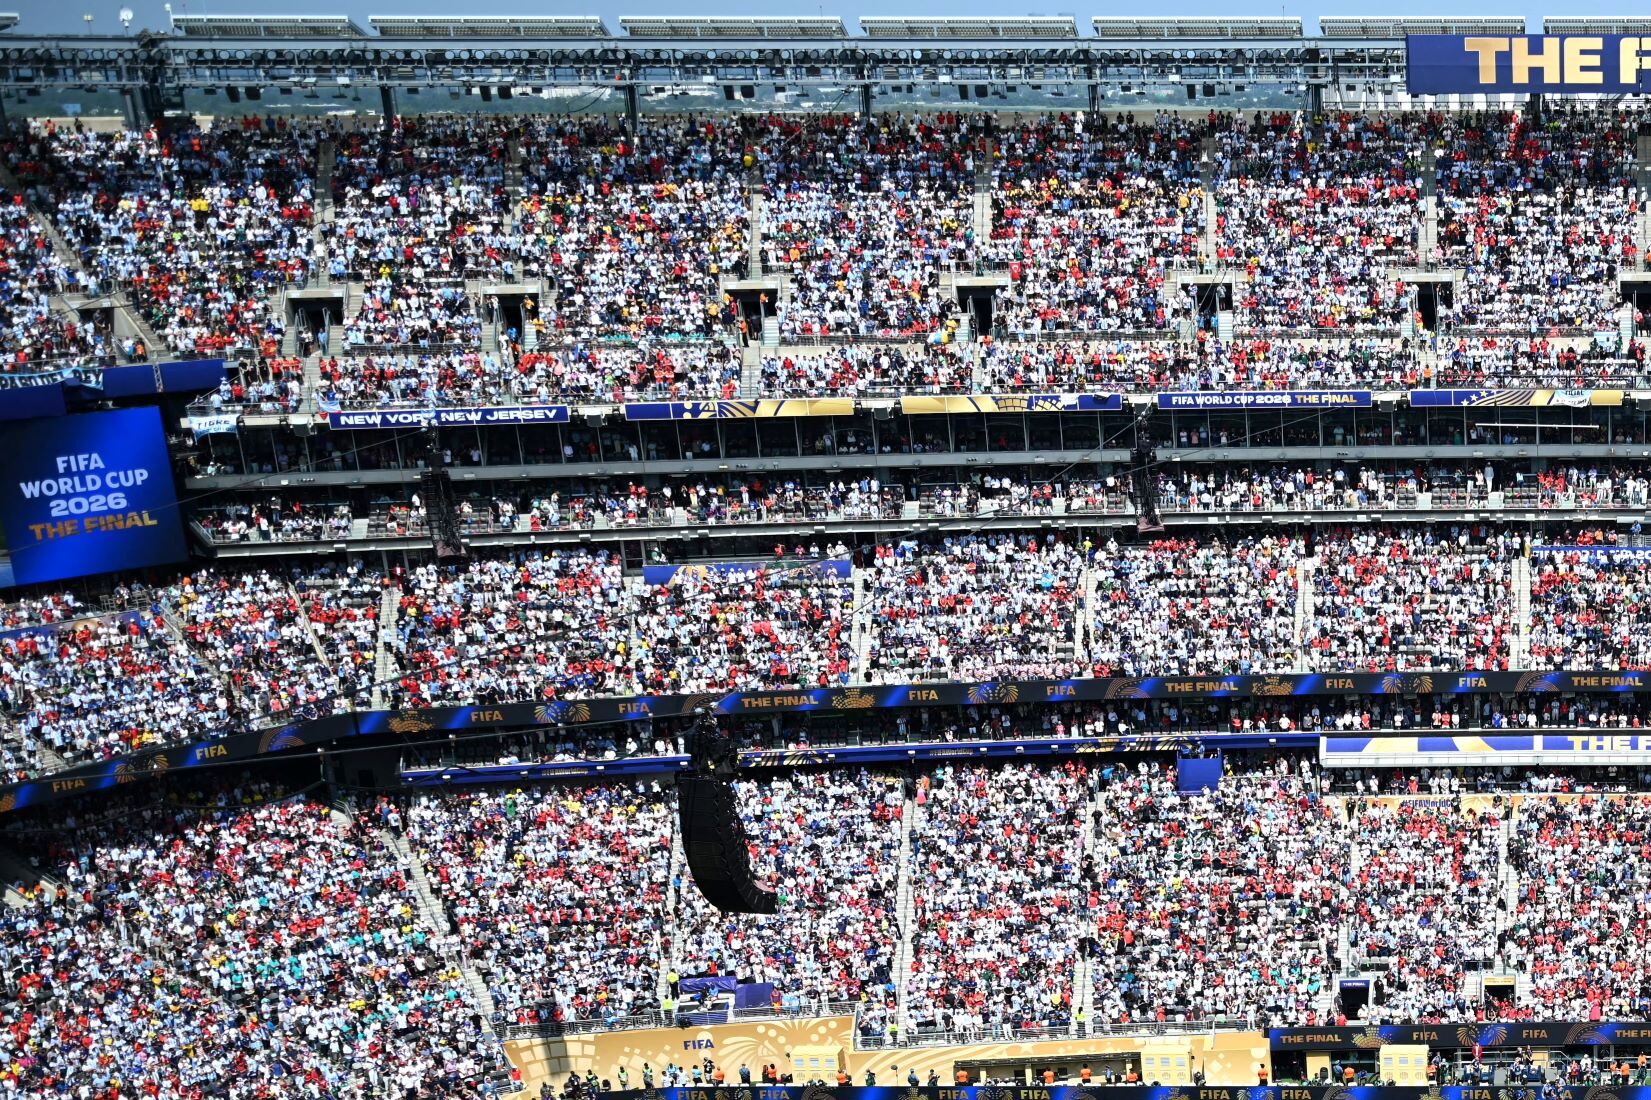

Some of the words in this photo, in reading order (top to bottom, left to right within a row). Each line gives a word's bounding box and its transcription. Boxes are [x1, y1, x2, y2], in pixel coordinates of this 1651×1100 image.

[1464, 36, 1603, 84] THE
[1172, 395, 1194, 405] FIFA
[1195, 395, 1232, 405] WORLD
[1234, 395, 1254, 405] CUP
[1256, 395, 1291, 404] 2026
[1295, 395, 1319, 404] THE
[1321, 394, 1357, 404] FINAL
[340, 414, 381, 425] NEW
[386, 412, 437, 424] YOR
[441, 411, 481, 421] NEW
[486, 409, 557, 421] JERSEY
[56, 452, 105, 474] FIFA
[20, 473, 102, 499] WORLD
[105, 469, 149, 489] CUP
[50, 492, 128, 517] 2026
[29, 519, 79, 540] THE
[84, 510, 158, 534] FINAL
[1165, 682, 1194, 692] THE
[1196, 681, 1239, 692] FINAL
[1325, 679, 1354, 689] FIFA
[1458, 678, 1487, 688] FIFA
[1572, 677, 1599, 686] THE
[1601, 676, 1643, 686] FINAL
[909, 690, 939, 701] FIFA
[1046, 685, 1076, 697] FIFA
[741, 697, 770, 709] THE
[773, 695, 818, 708] FINAL
[618, 702, 650, 714] FIFA
[470, 710, 503, 722] FIFA
[1567, 735, 1631, 750] THE
[195, 745, 228, 760] FIFA
[52, 777, 86, 793] FIFA
[1280, 1035, 1304, 1043] THE
[1306, 1034, 1341, 1043] FINAL
[1412, 1032, 1438, 1041] FIFA
[1522, 1030, 1547, 1038] FIFA
[684, 1039, 715, 1050] FIFA
[677, 1091, 708, 1100] FIFA
[759, 1090, 790, 1100] FIFA
[939, 1090, 969, 1100] FIFA
[1020, 1090, 1051, 1100] FIFA
[1200, 1090, 1230, 1100] FIFA
[1282, 1090, 1311, 1100] FIFA
[1461, 1090, 1490, 1100] FIFA
